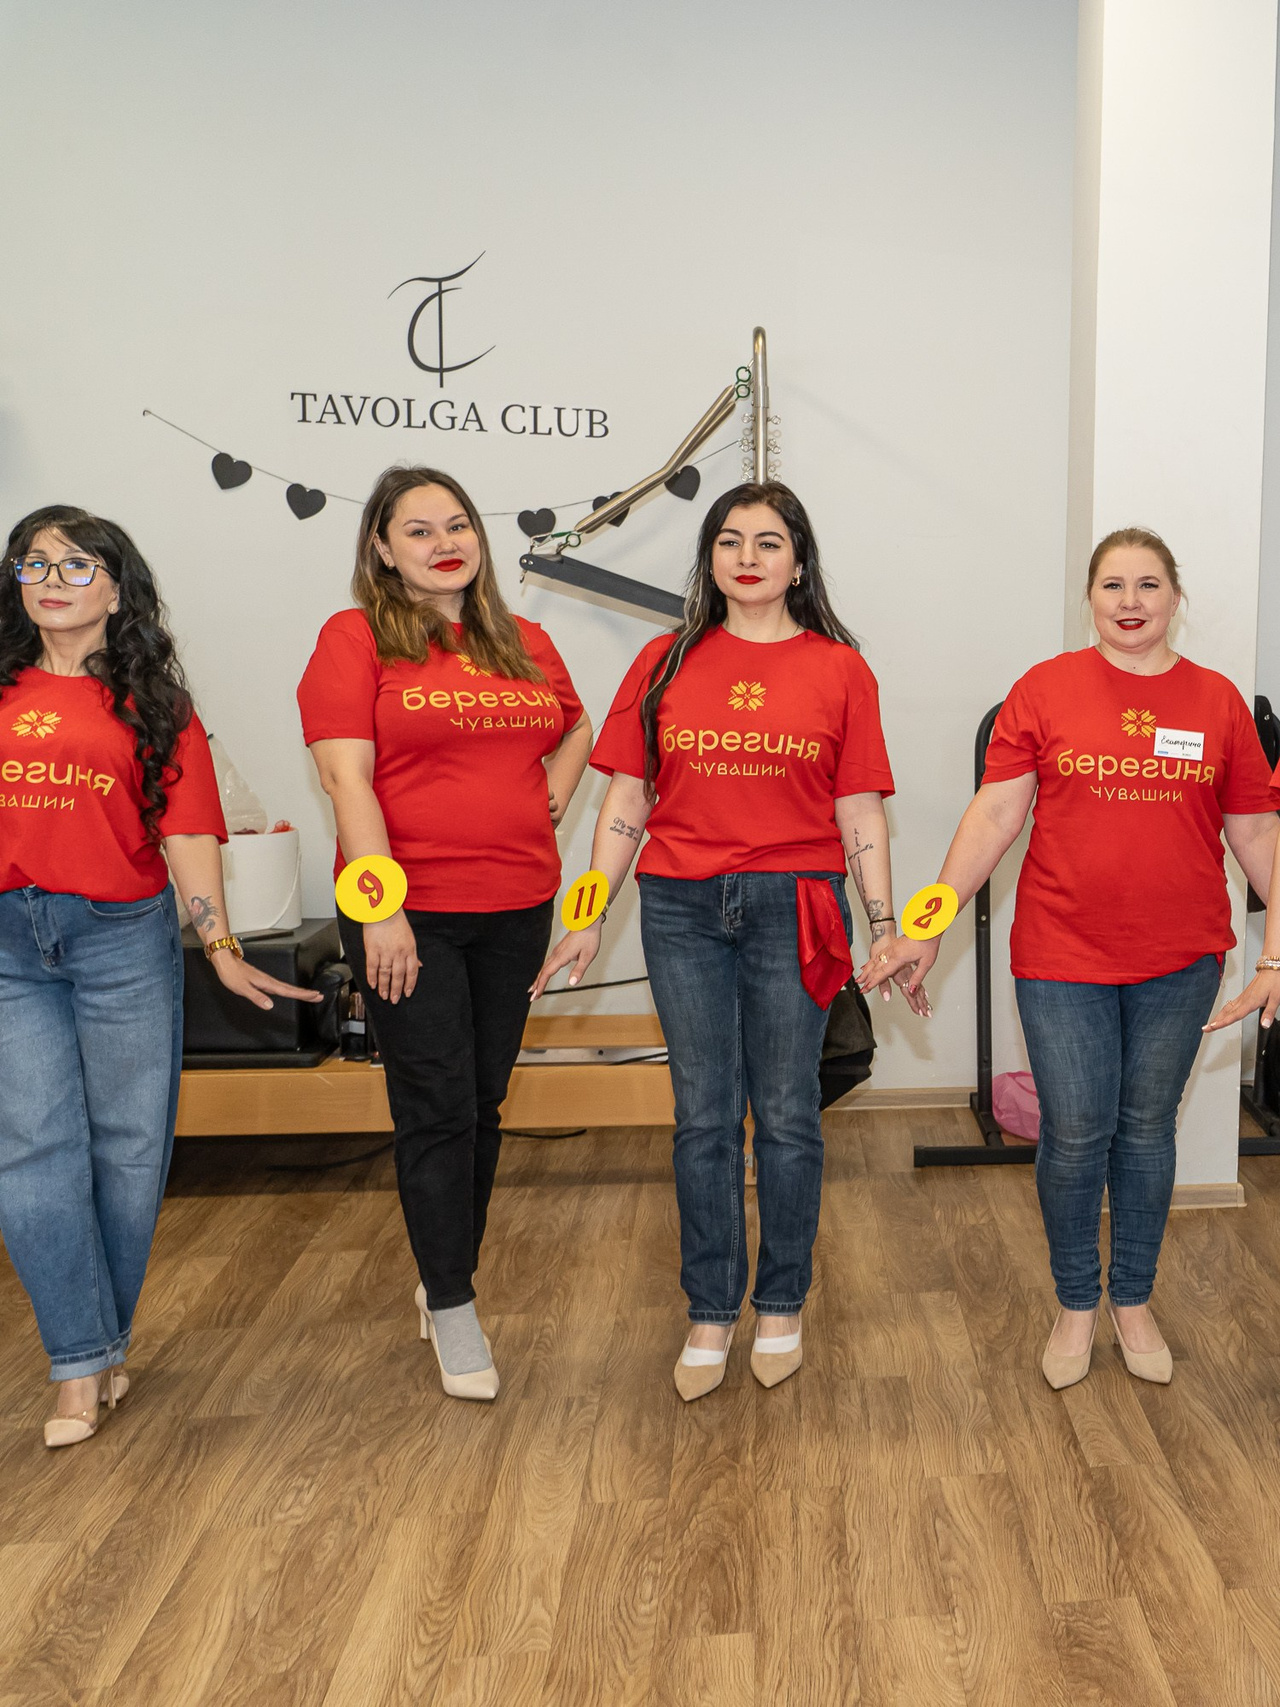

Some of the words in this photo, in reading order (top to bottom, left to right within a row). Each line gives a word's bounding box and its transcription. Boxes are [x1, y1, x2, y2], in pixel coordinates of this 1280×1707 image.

[290, 392, 488, 432] TAVOLGA
[500, 404, 609, 438] CLUB
[402, 685, 561, 713] берегин
[449, 715, 555, 732] чувашии
[662, 724, 821, 763] берегиня
[1, 760, 116, 796] егиня
[689, 760, 786, 778] чувашии
[1057, 748, 1216, 786] берегиня
[0, 793, 75, 811] вашии
[1089, 785, 1184, 802] чувашии
[357, 869, 384, 909] 9
[573, 882, 598, 921] 11
[912, 896, 943, 930] 2
